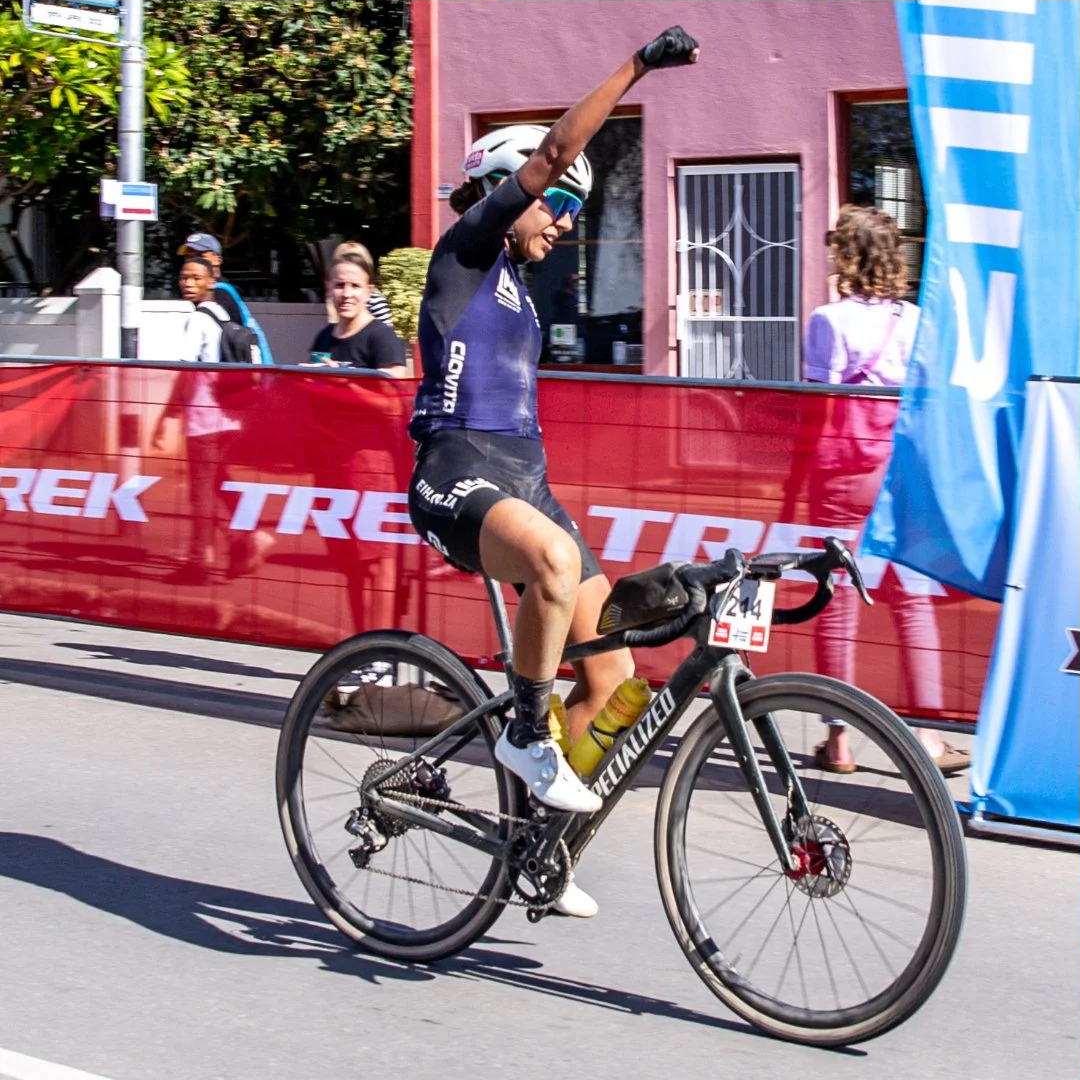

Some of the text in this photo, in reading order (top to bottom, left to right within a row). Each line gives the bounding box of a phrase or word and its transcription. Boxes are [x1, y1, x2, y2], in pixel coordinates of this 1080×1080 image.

[443, 340, 467, 414] CIOVITA
[220, 481, 428, 545] TRE
[725, 594, 762, 621] 214
[590, 687, 676, 797] PECIALIZED
